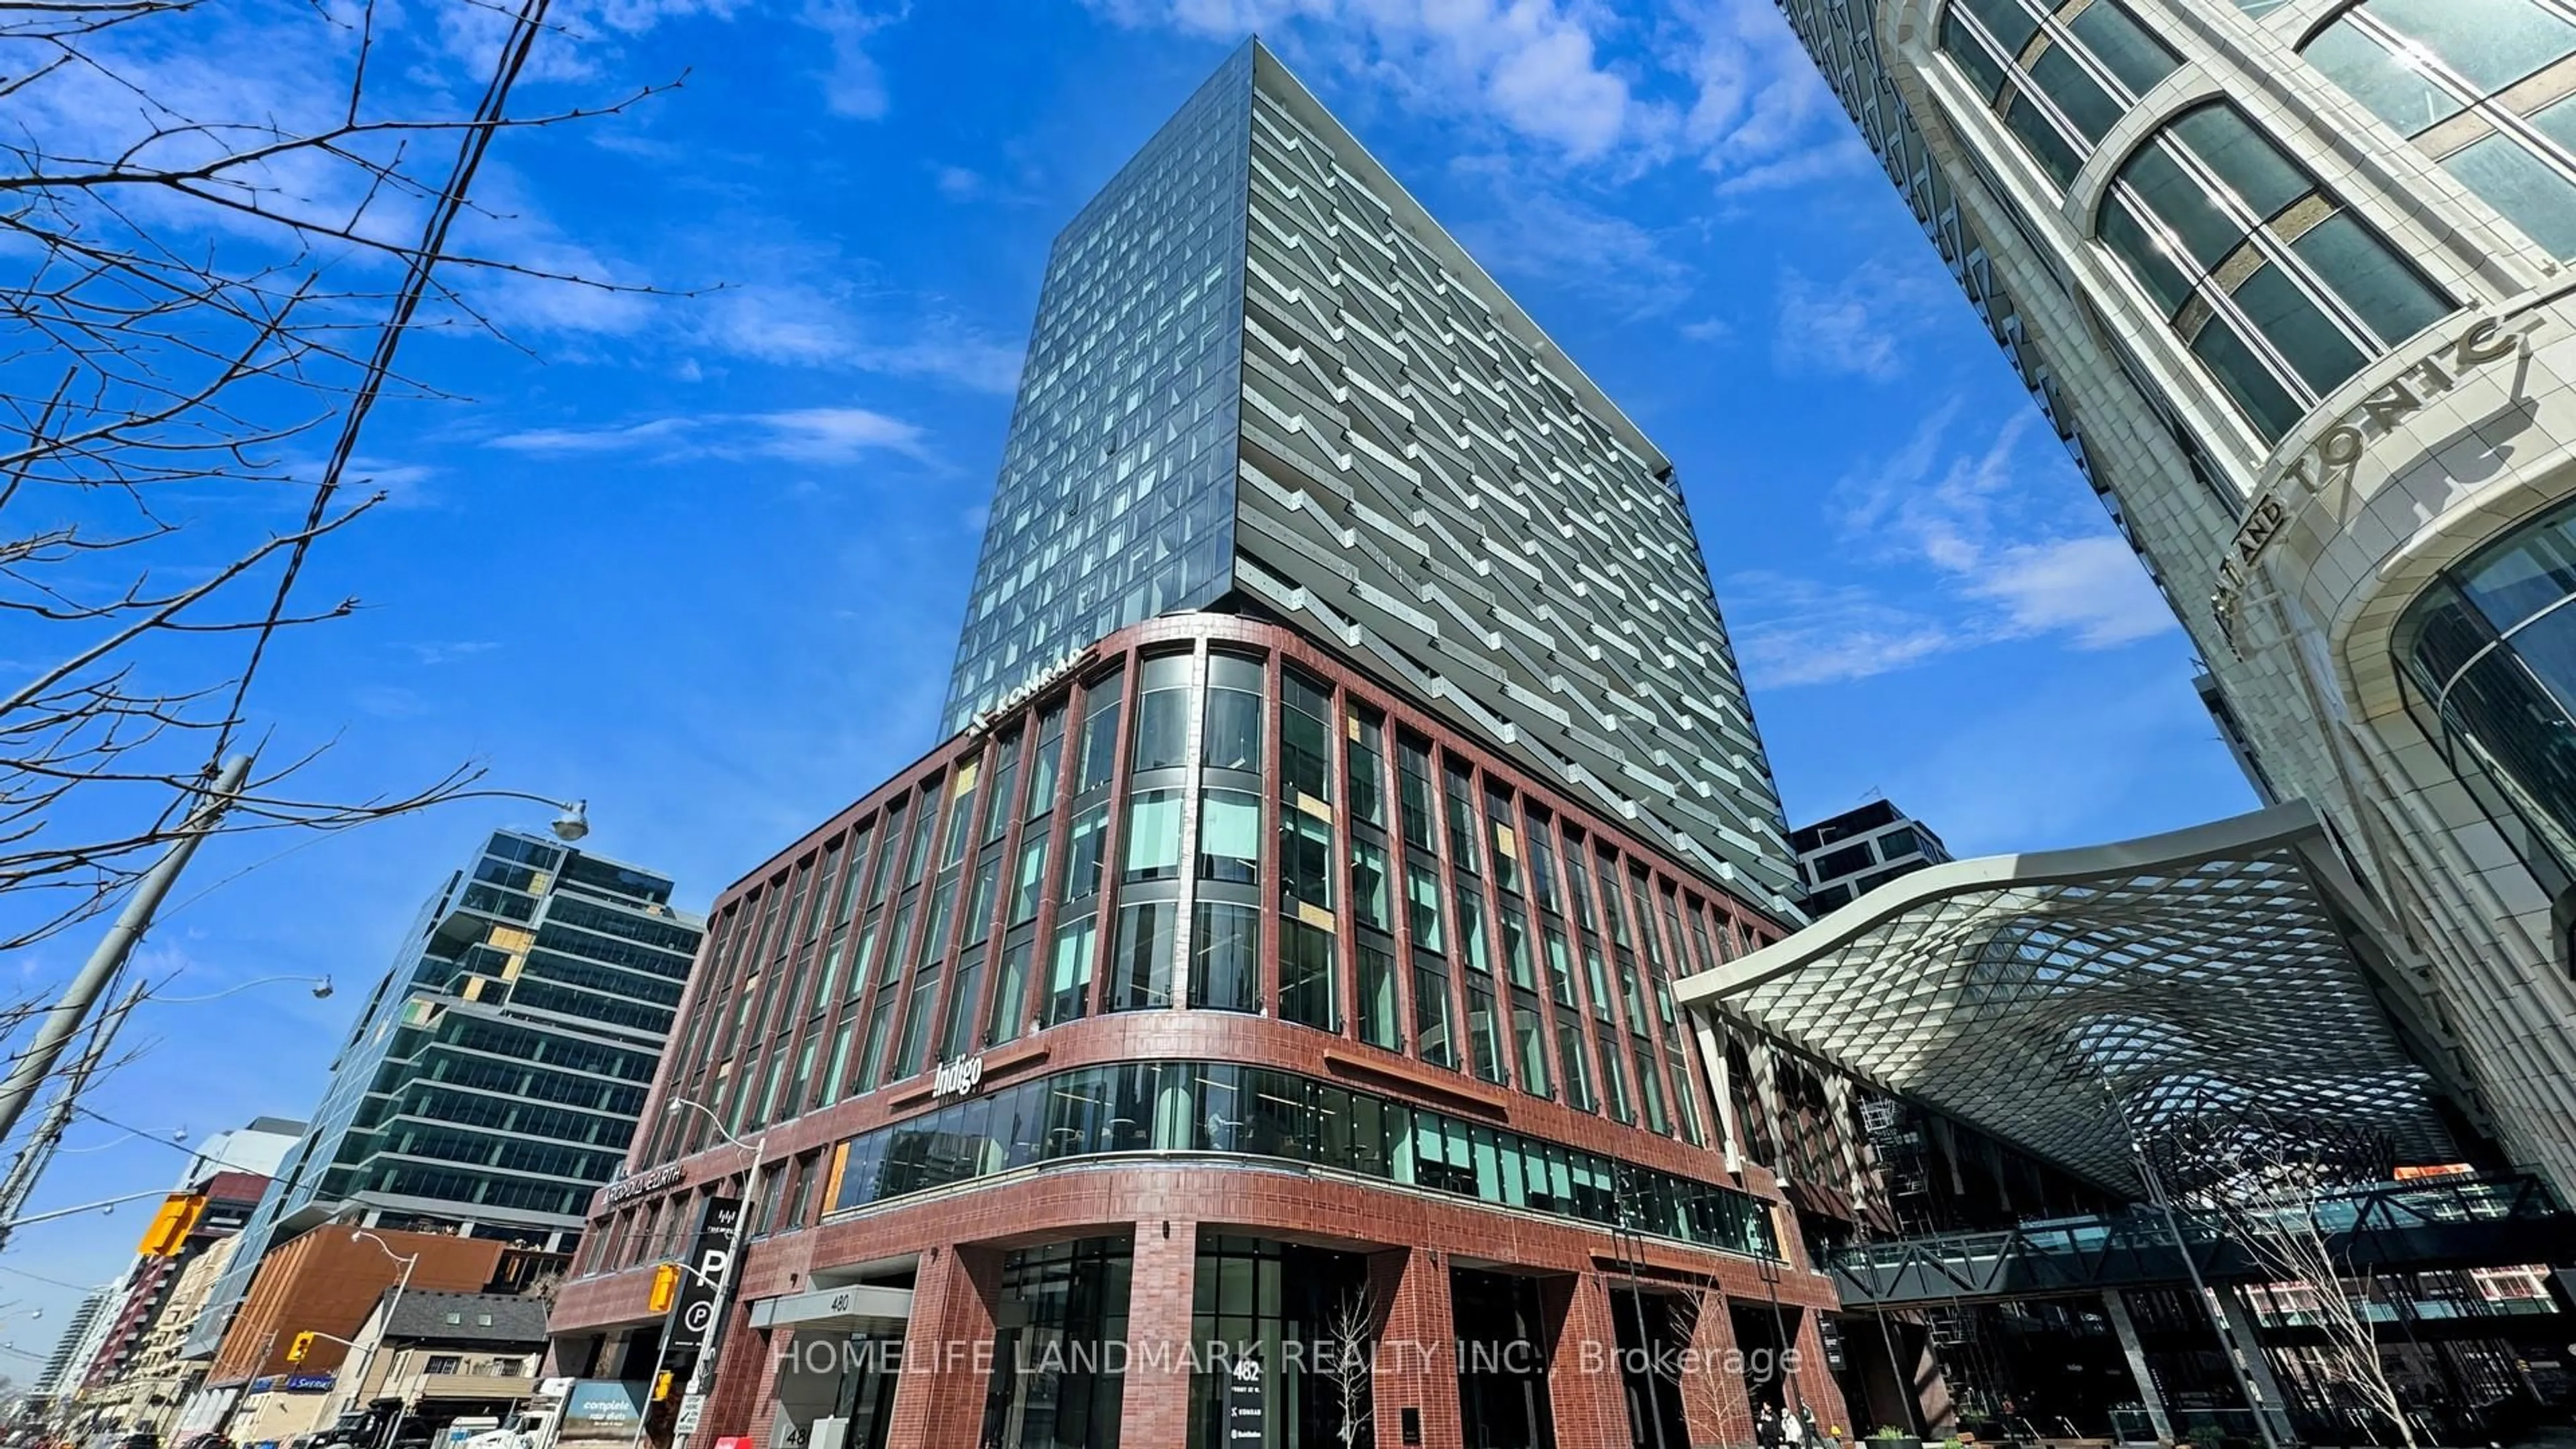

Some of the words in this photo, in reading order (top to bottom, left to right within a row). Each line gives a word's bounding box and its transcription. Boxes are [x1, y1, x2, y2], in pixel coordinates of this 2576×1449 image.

[2238, 501, 2282, 562] AND
[2285, 315, 2520, 495] TONIC
[996, 648, 1083, 715] KONRAD
[696, 1249, 727, 1287] P
[831, 1294, 849, 1313] 480
[694, 1307, 707, 1324] P
[1233, 1359, 1259, 1381] 482
[583, 1399, 630, 1412] complete
[786, 1428, 811, 1446] 48
